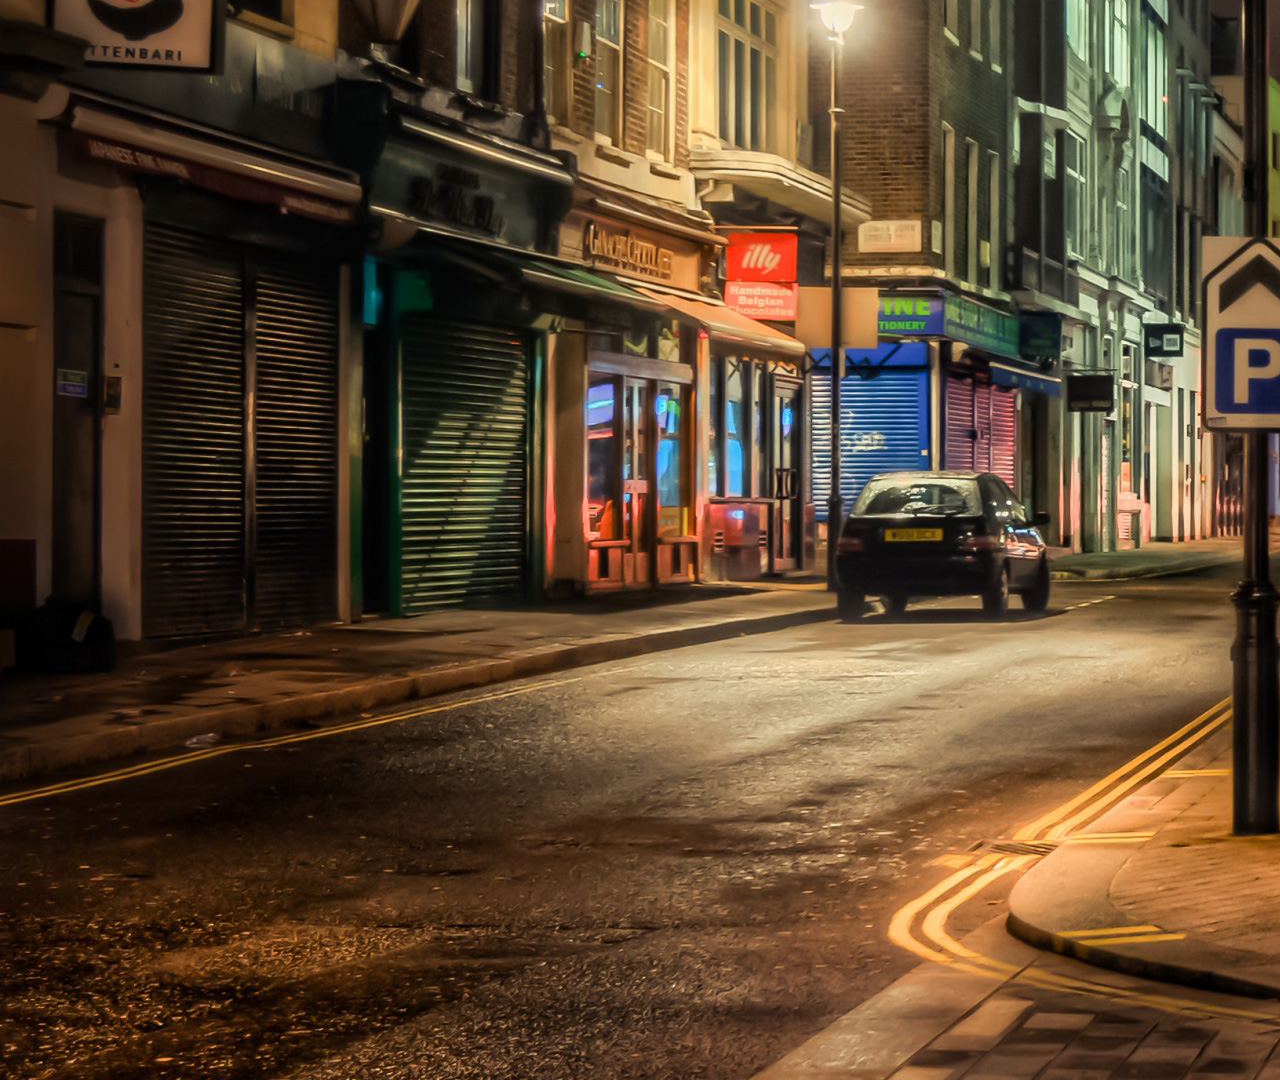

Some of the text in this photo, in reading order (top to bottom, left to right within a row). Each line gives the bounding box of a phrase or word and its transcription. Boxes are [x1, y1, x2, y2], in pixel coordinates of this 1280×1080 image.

[89, 44, 182, 62] TTENBARI
[742, 243, 781, 276] illy
[729, 286, 793, 297] Handmade
[738, 296, 784, 308] Belgian
[884, 298, 931, 316] INE
